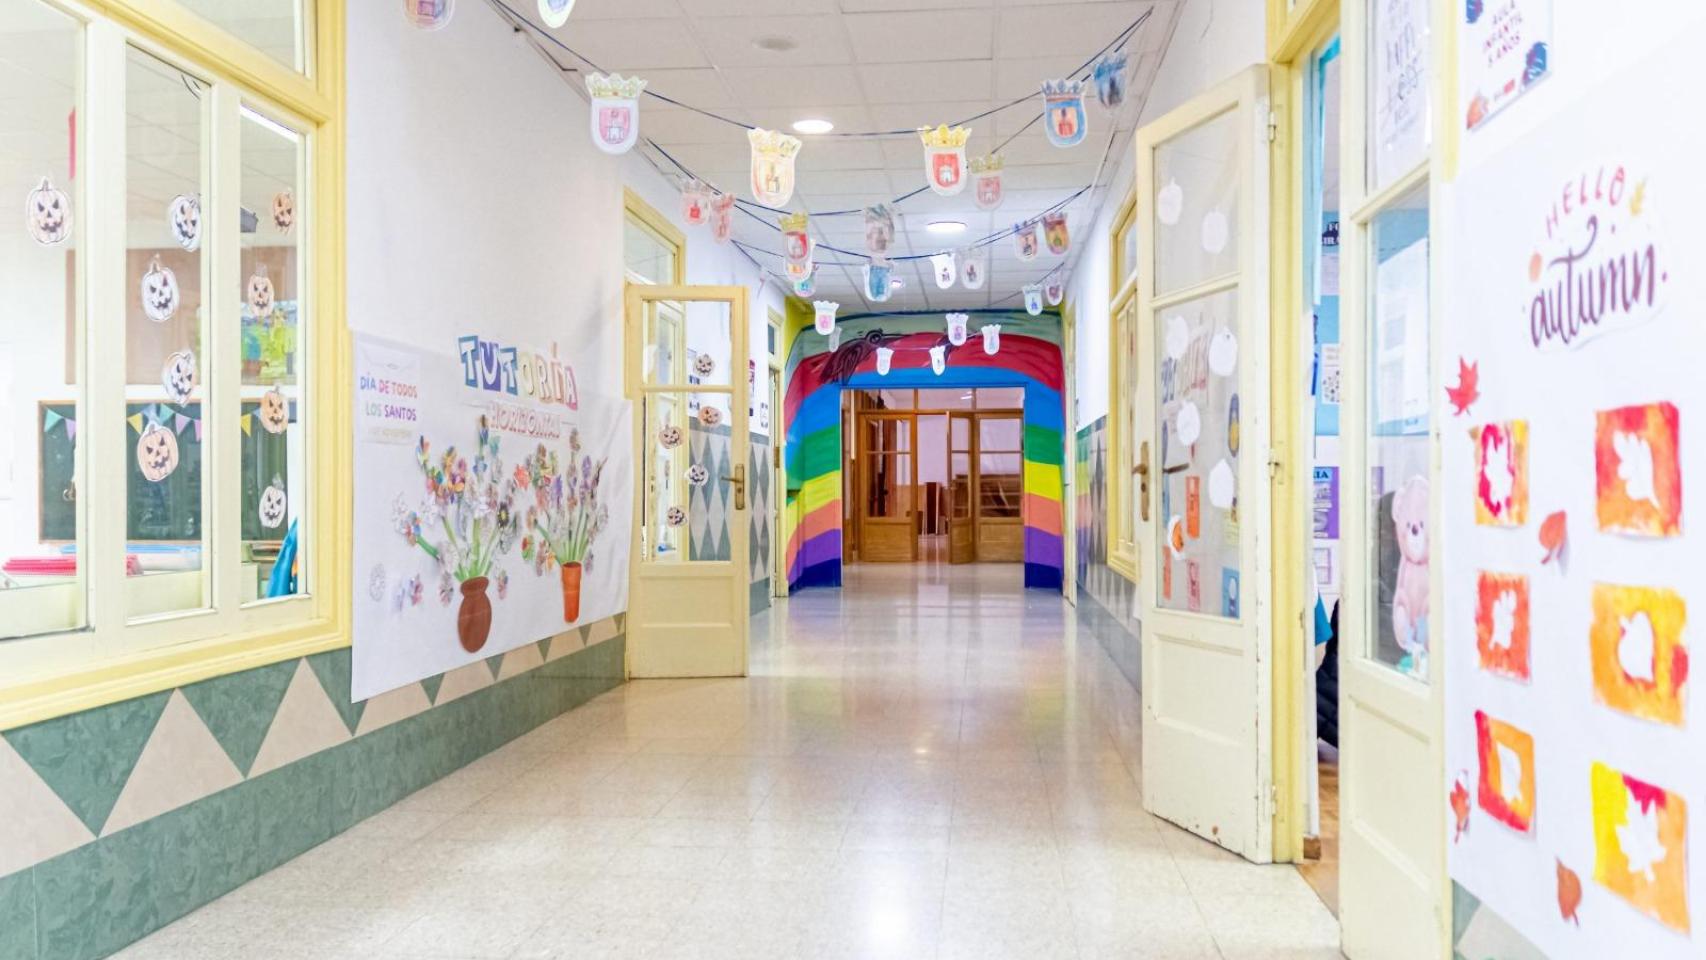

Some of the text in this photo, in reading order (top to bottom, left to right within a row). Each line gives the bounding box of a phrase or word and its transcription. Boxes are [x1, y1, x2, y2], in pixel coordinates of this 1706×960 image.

[1546, 166, 1625, 239] HELLO
[359, 371, 418, 399] DÍA DE TODOS
[458, 335, 578, 411] TUTORÍA
[366, 401, 417, 422] LOS SANTOS
